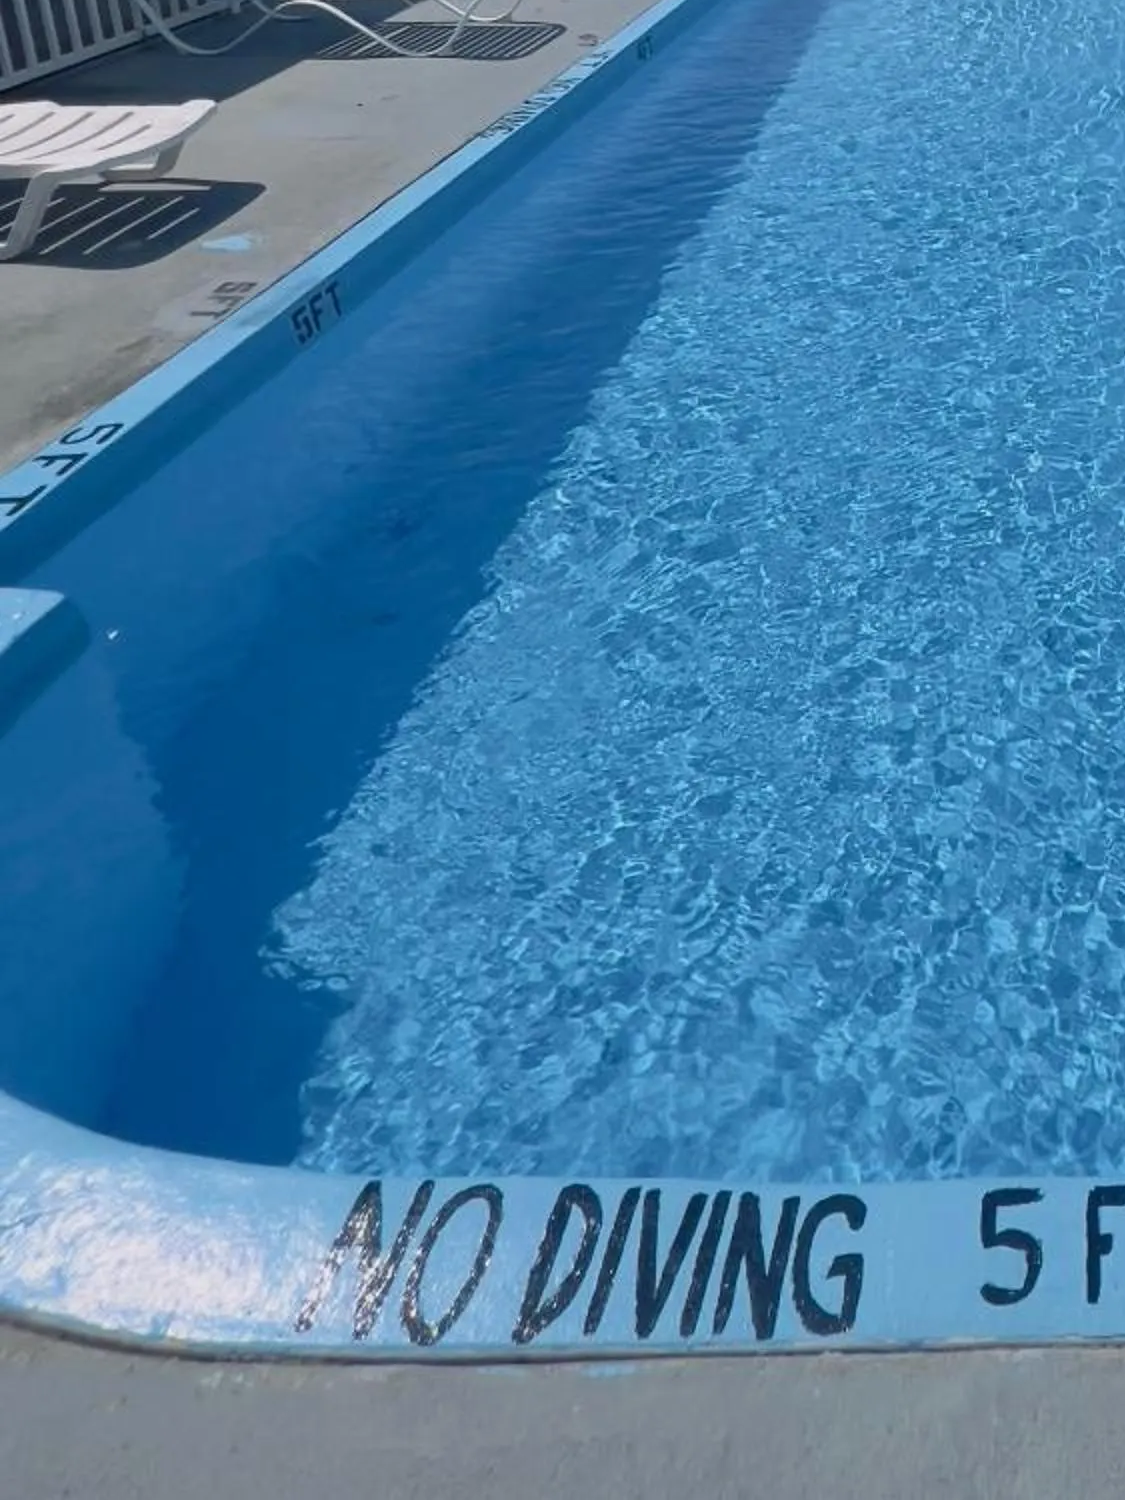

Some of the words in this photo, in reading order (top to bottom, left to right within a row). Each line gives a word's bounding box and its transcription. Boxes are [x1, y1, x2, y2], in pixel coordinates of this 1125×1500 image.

[290, 281, 343, 345] 5FT
[292, 1179, 504, 1347] NO
[511, 1182, 868, 1345] DIVING
